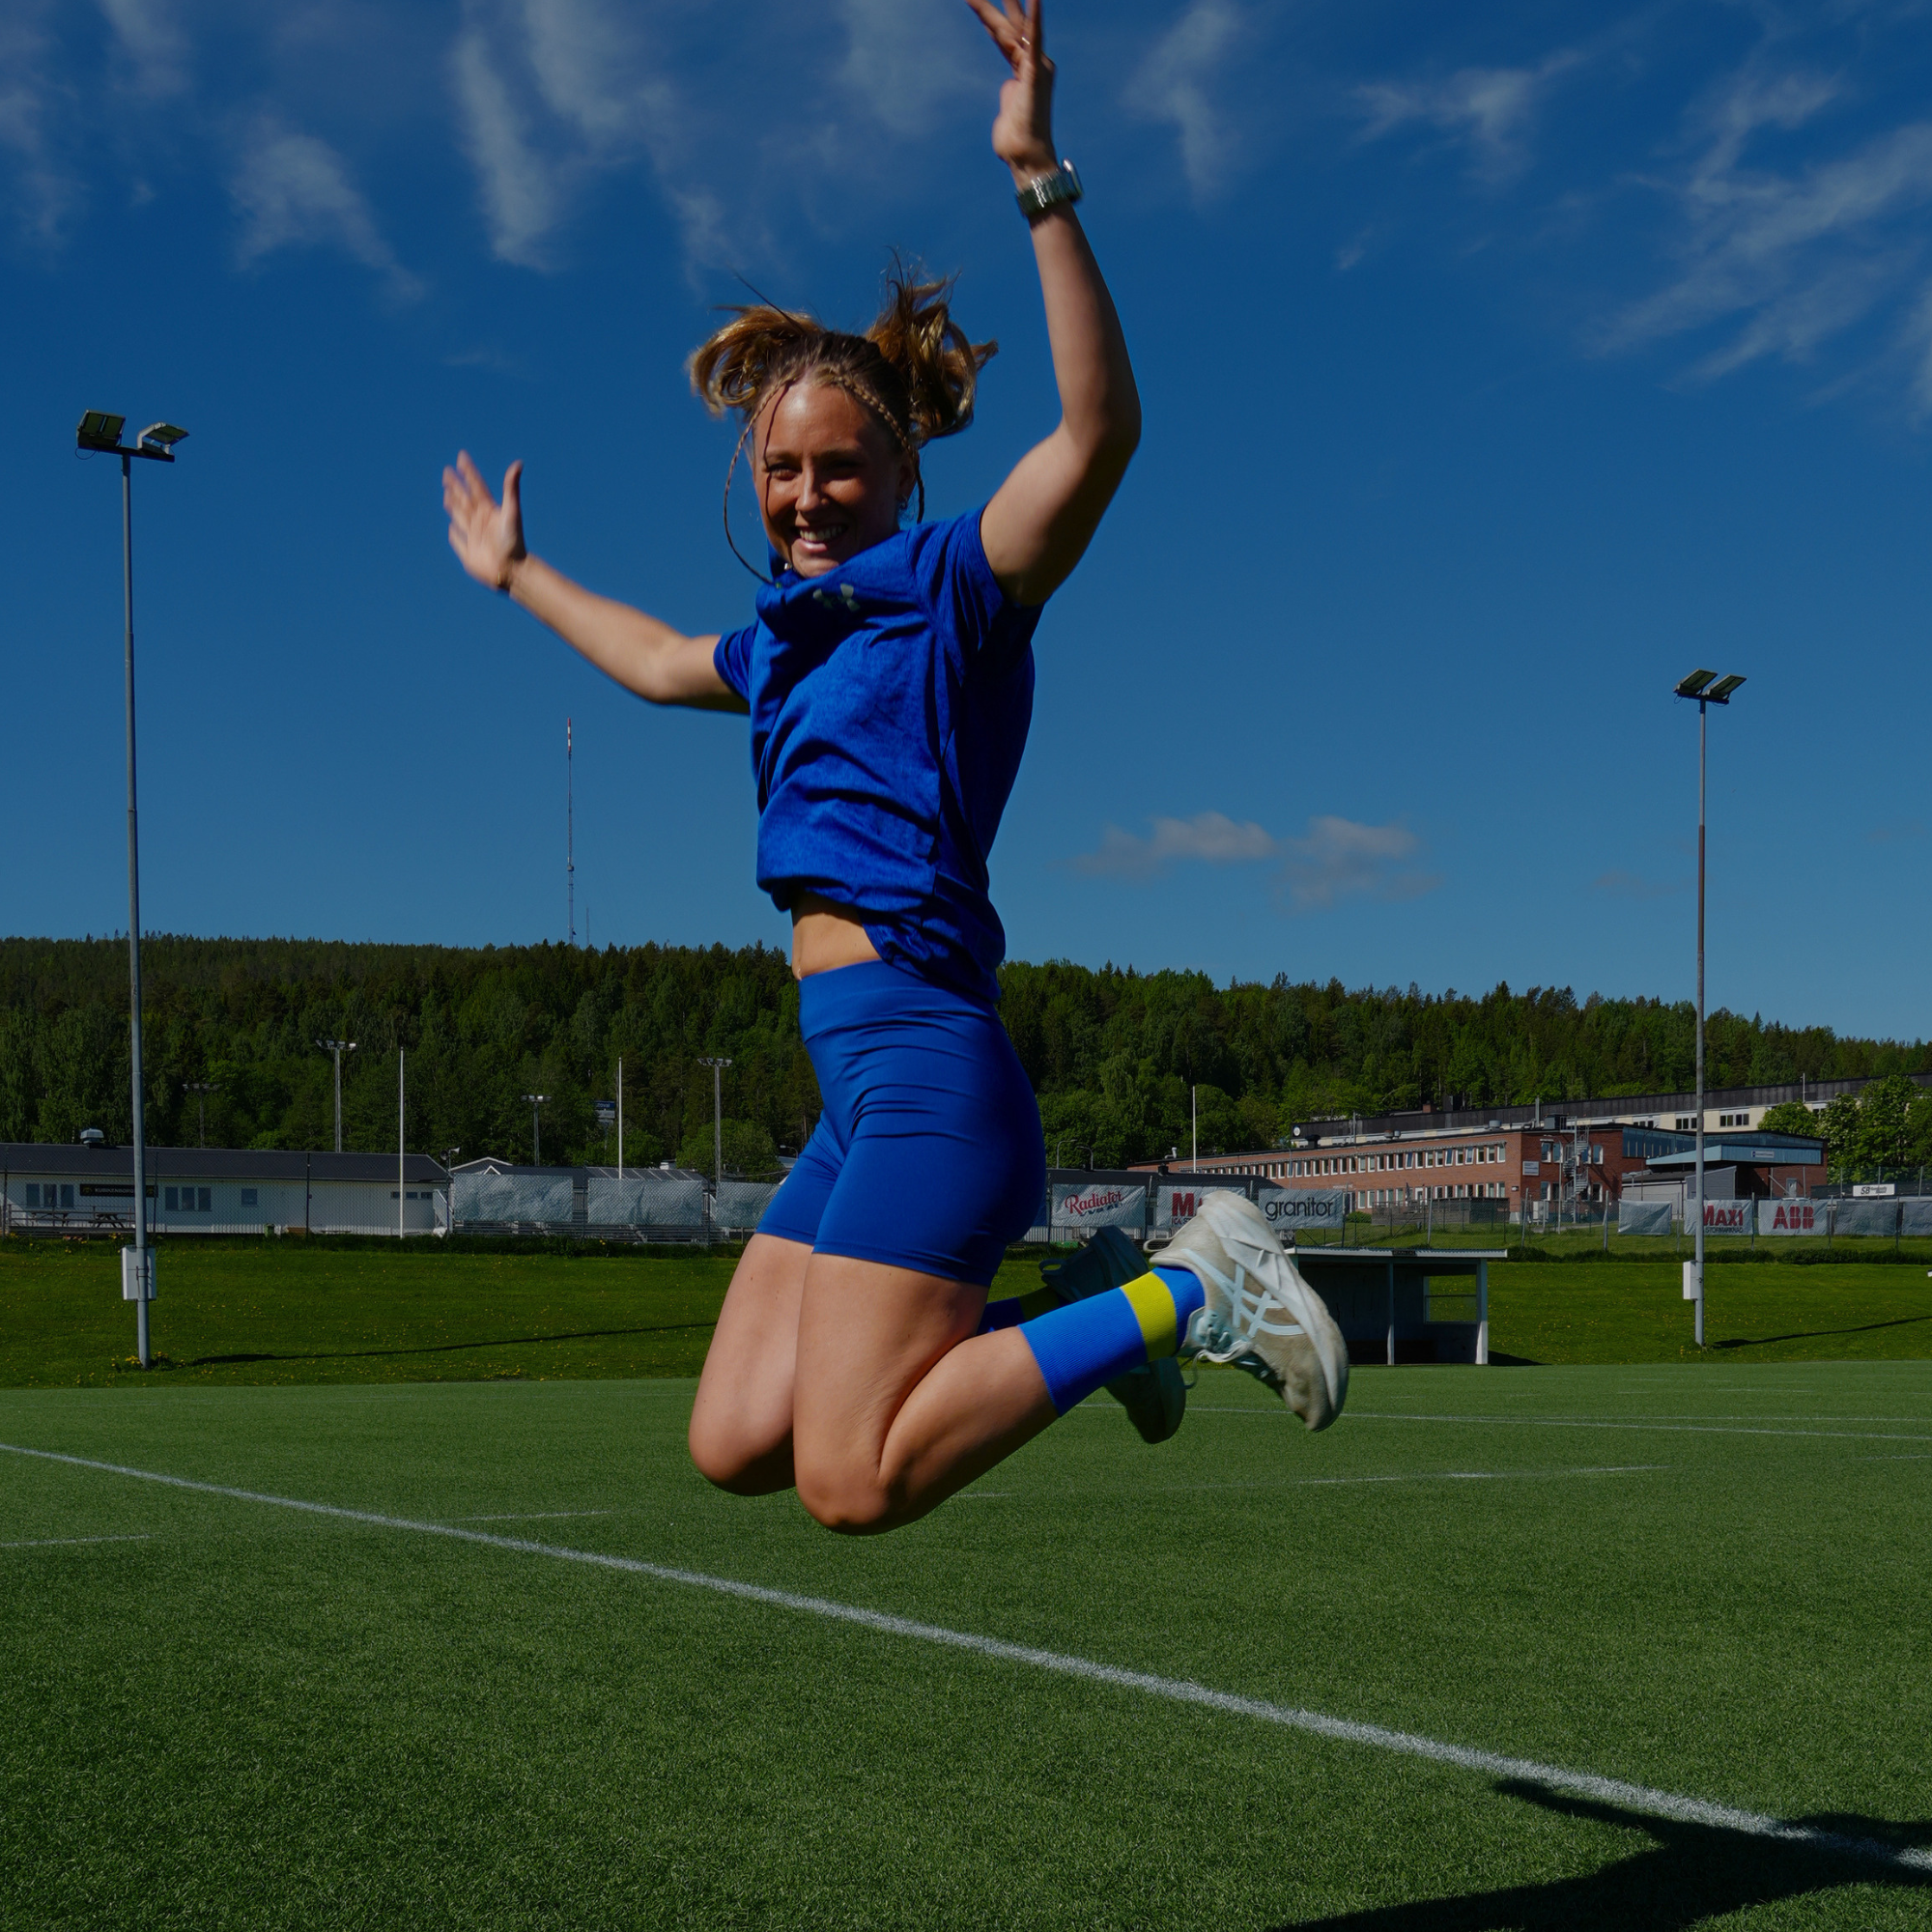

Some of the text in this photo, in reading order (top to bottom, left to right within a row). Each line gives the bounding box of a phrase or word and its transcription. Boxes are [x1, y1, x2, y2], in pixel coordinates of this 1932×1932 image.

[1065, 1191, 1124, 1214] Radiator
[1264, 1197, 1333, 1221] granitor
[1773, 1206, 1814, 1229] ABB
